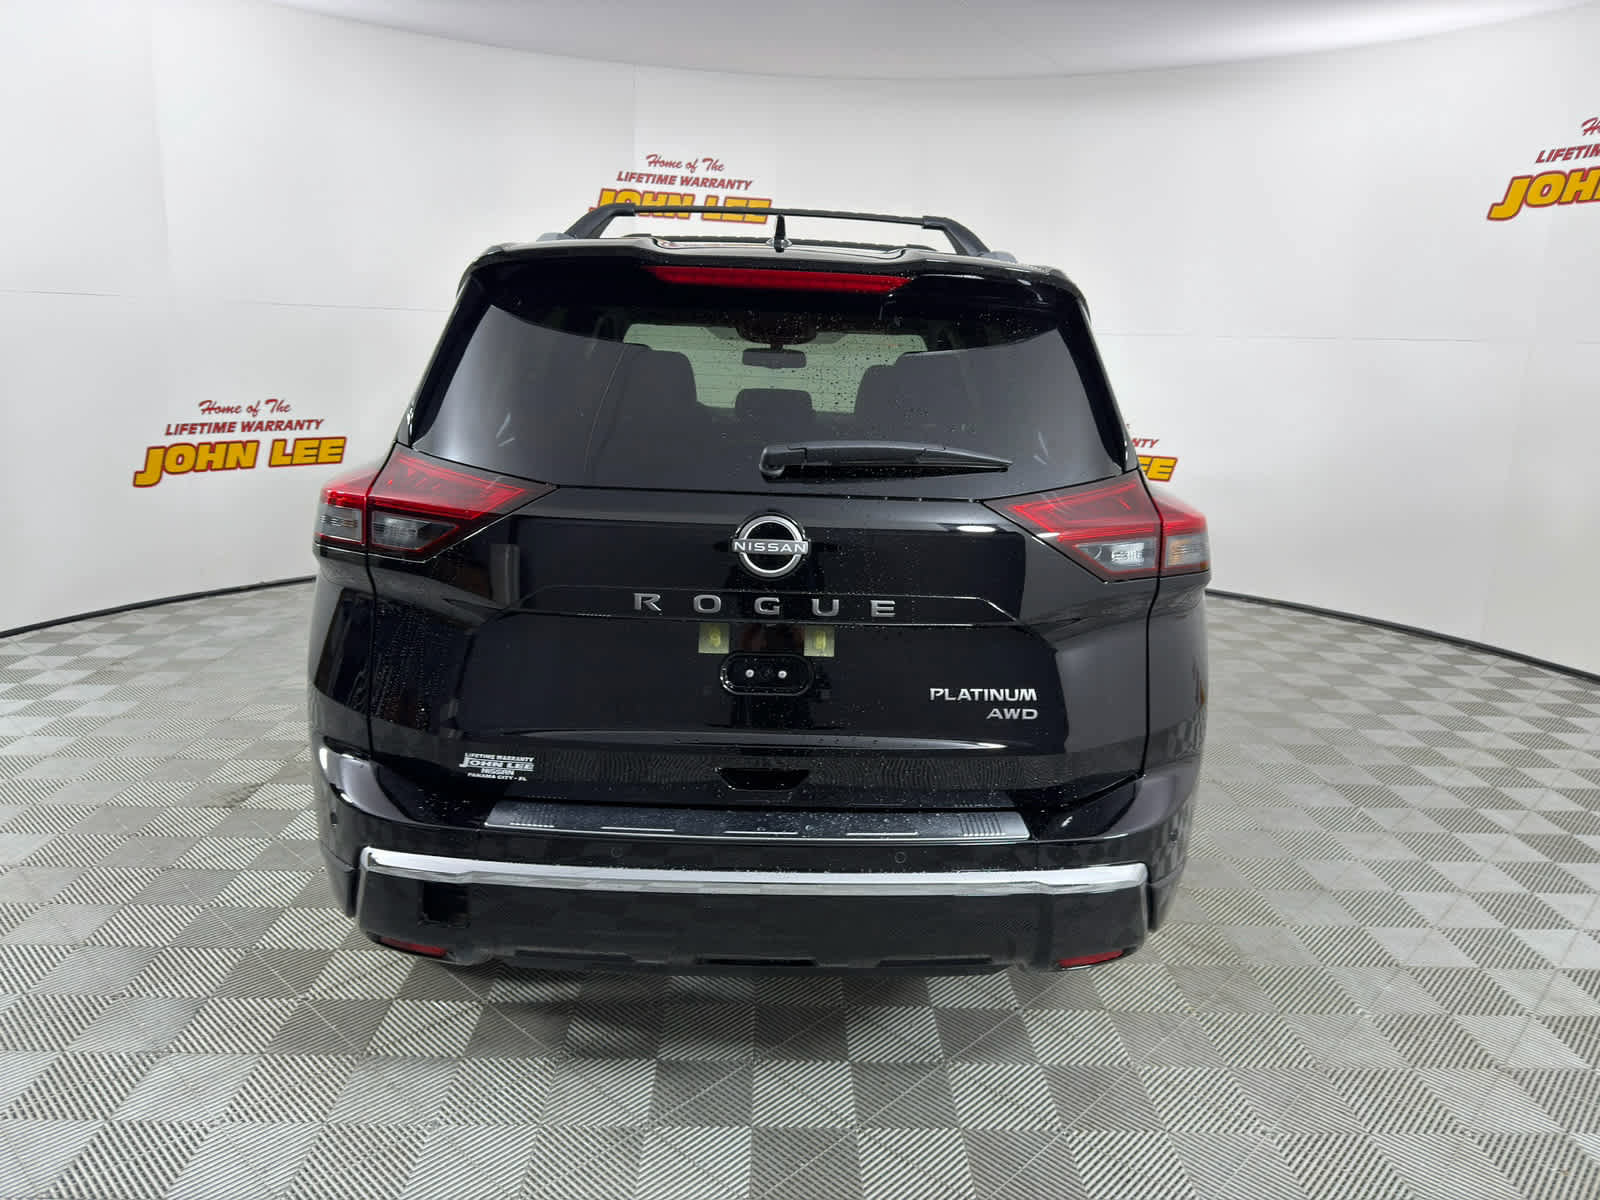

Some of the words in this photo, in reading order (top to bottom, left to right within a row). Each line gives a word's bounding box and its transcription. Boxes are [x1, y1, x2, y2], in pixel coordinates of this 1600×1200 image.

[646, 154, 684, 169] Home
[685, 158, 699, 174] of
[702, 157, 725, 172] The
[616, 171, 677, 186] LIFETIME
[679, 175, 752, 191] WARRANTY
[701, 195, 772, 225] LEE
[198, 399, 242, 415] Home
[246, 400, 261, 417] of
[264, 398, 292, 414] The
[165, 421, 237, 436] LIFETIME
[240, 418, 324, 433] WARRANTY
[133, 440, 260, 488] JOHN
[268, 436, 347, 467] LEE
[1136, 454, 1178, 482] EE
[733, 541, 808, 554] NISSAN
[633, 592, 896, 617] ROGUE
[929, 688, 1037, 702] PLATINUM
[986, 708, 1038, 720] AWD
[459, 756, 503, 769] JOHN
[506, 761, 535, 771] LEE
[464, 752, 496, 760] LIFETIME
